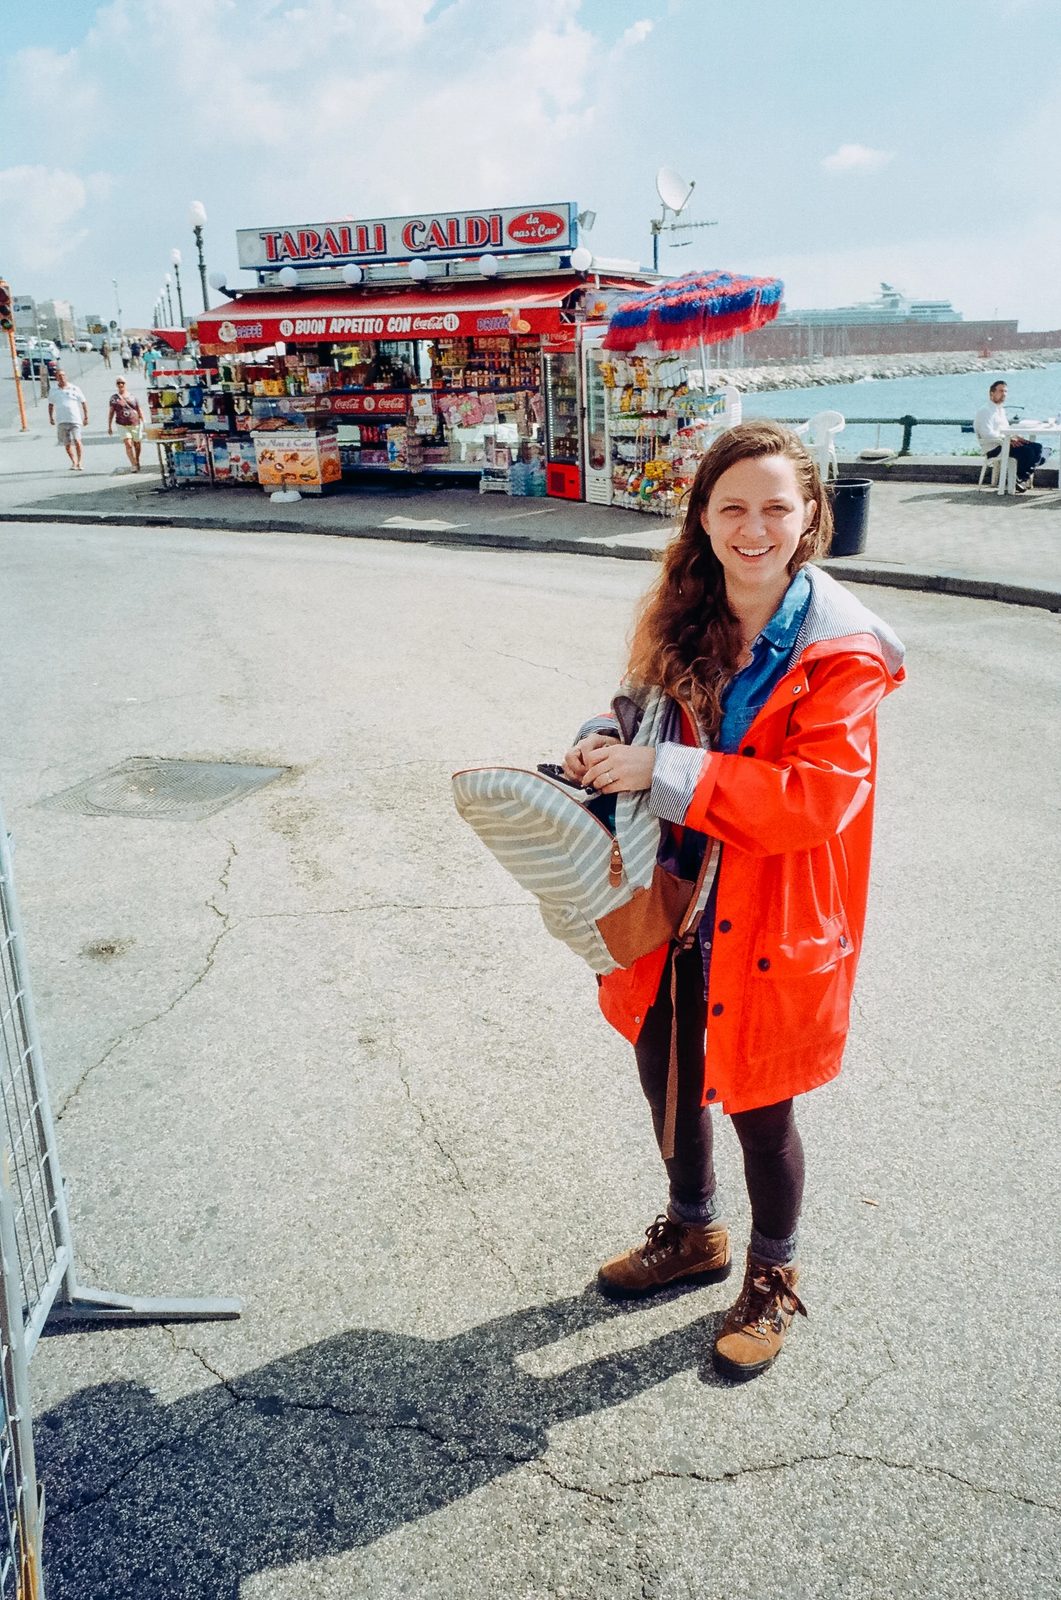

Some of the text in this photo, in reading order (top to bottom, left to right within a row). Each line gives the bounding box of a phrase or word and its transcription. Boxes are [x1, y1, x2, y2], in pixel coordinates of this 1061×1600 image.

[526, 213, 540, 225] da
[259, 214, 503, 262] TARALLI CALDI
[295, 319, 326, 335] BUON
[328, 318, 384, 334] APPETITO
[387, 316, 412, 333] CON
[334, 398, 360, 409] Coca-Cola
[378, 397, 405, 409] Coca-Cola
